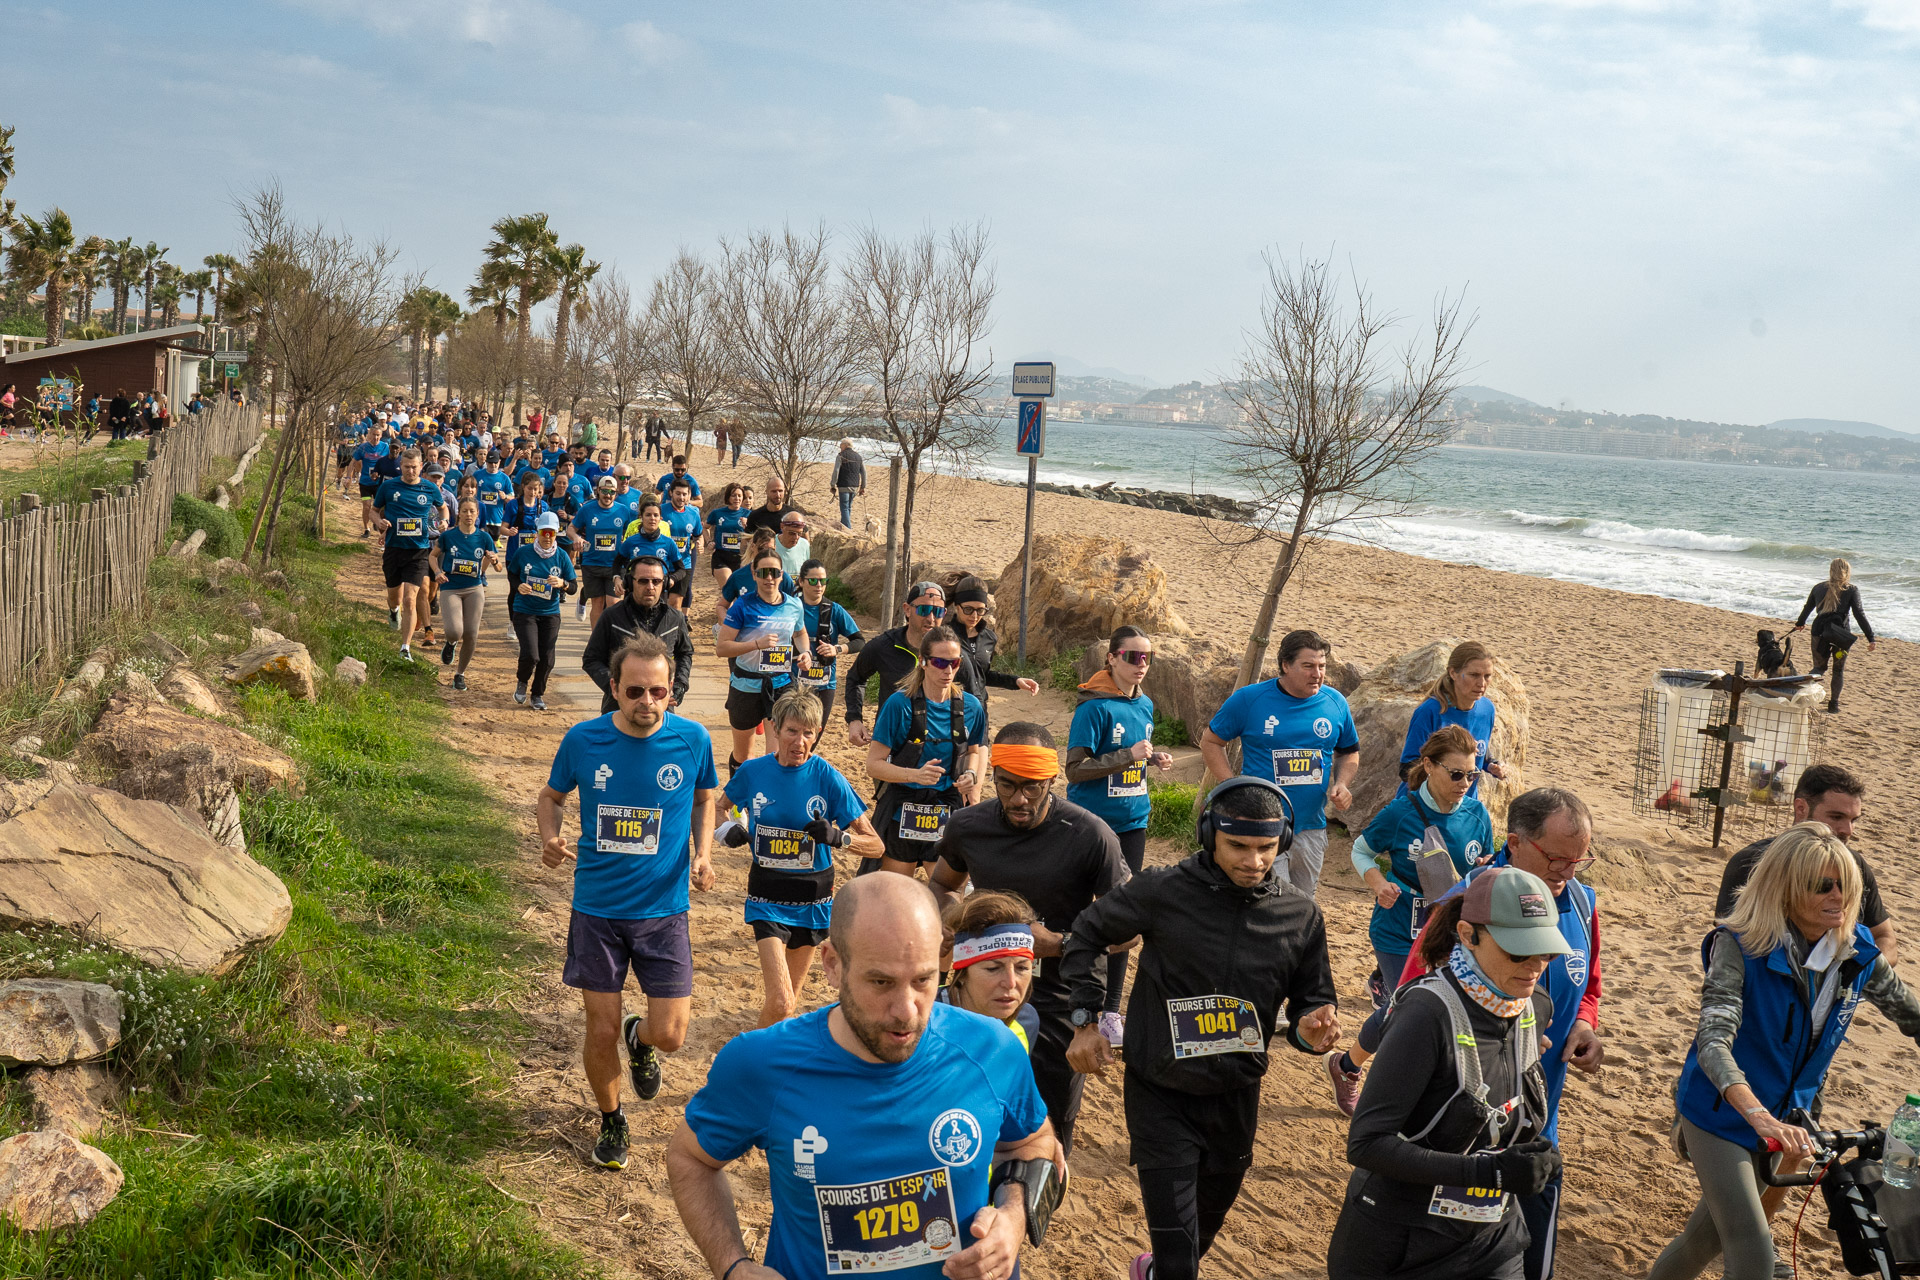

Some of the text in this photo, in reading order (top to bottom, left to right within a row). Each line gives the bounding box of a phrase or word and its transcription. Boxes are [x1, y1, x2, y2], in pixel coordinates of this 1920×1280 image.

[1015, 375, 1050, 384] PLAGE PUBLIQUE
[532, 582, 546, 592] 550
[769, 653, 785, 663] 1254
[808, 668, 824, 678] 1079
[1287, 759, 1310, 772] 1277
[1122, 770, 1141, 784] 1164
[599, 806, 623, 818] COURSE
[623, 808, 632, 818] DE
[614, 819, 642, 838] 1115
[915, 814, 939, 829] 1183
[757, 827, 779, 838] COURSE
[779, 829, 787, 838] DE
[769, 839, 800, 855] 1034
[1170, 1000, 1204, 1013] COURSE
[1204, 998, 1217, 1010] DE
[1194, 1011, 1237, 1034] 1041
[819, 1187, 869, 1206] COURSE
[870, 1184, 888, 1202] DE
[853, 1200, 920, 1241] 1279
